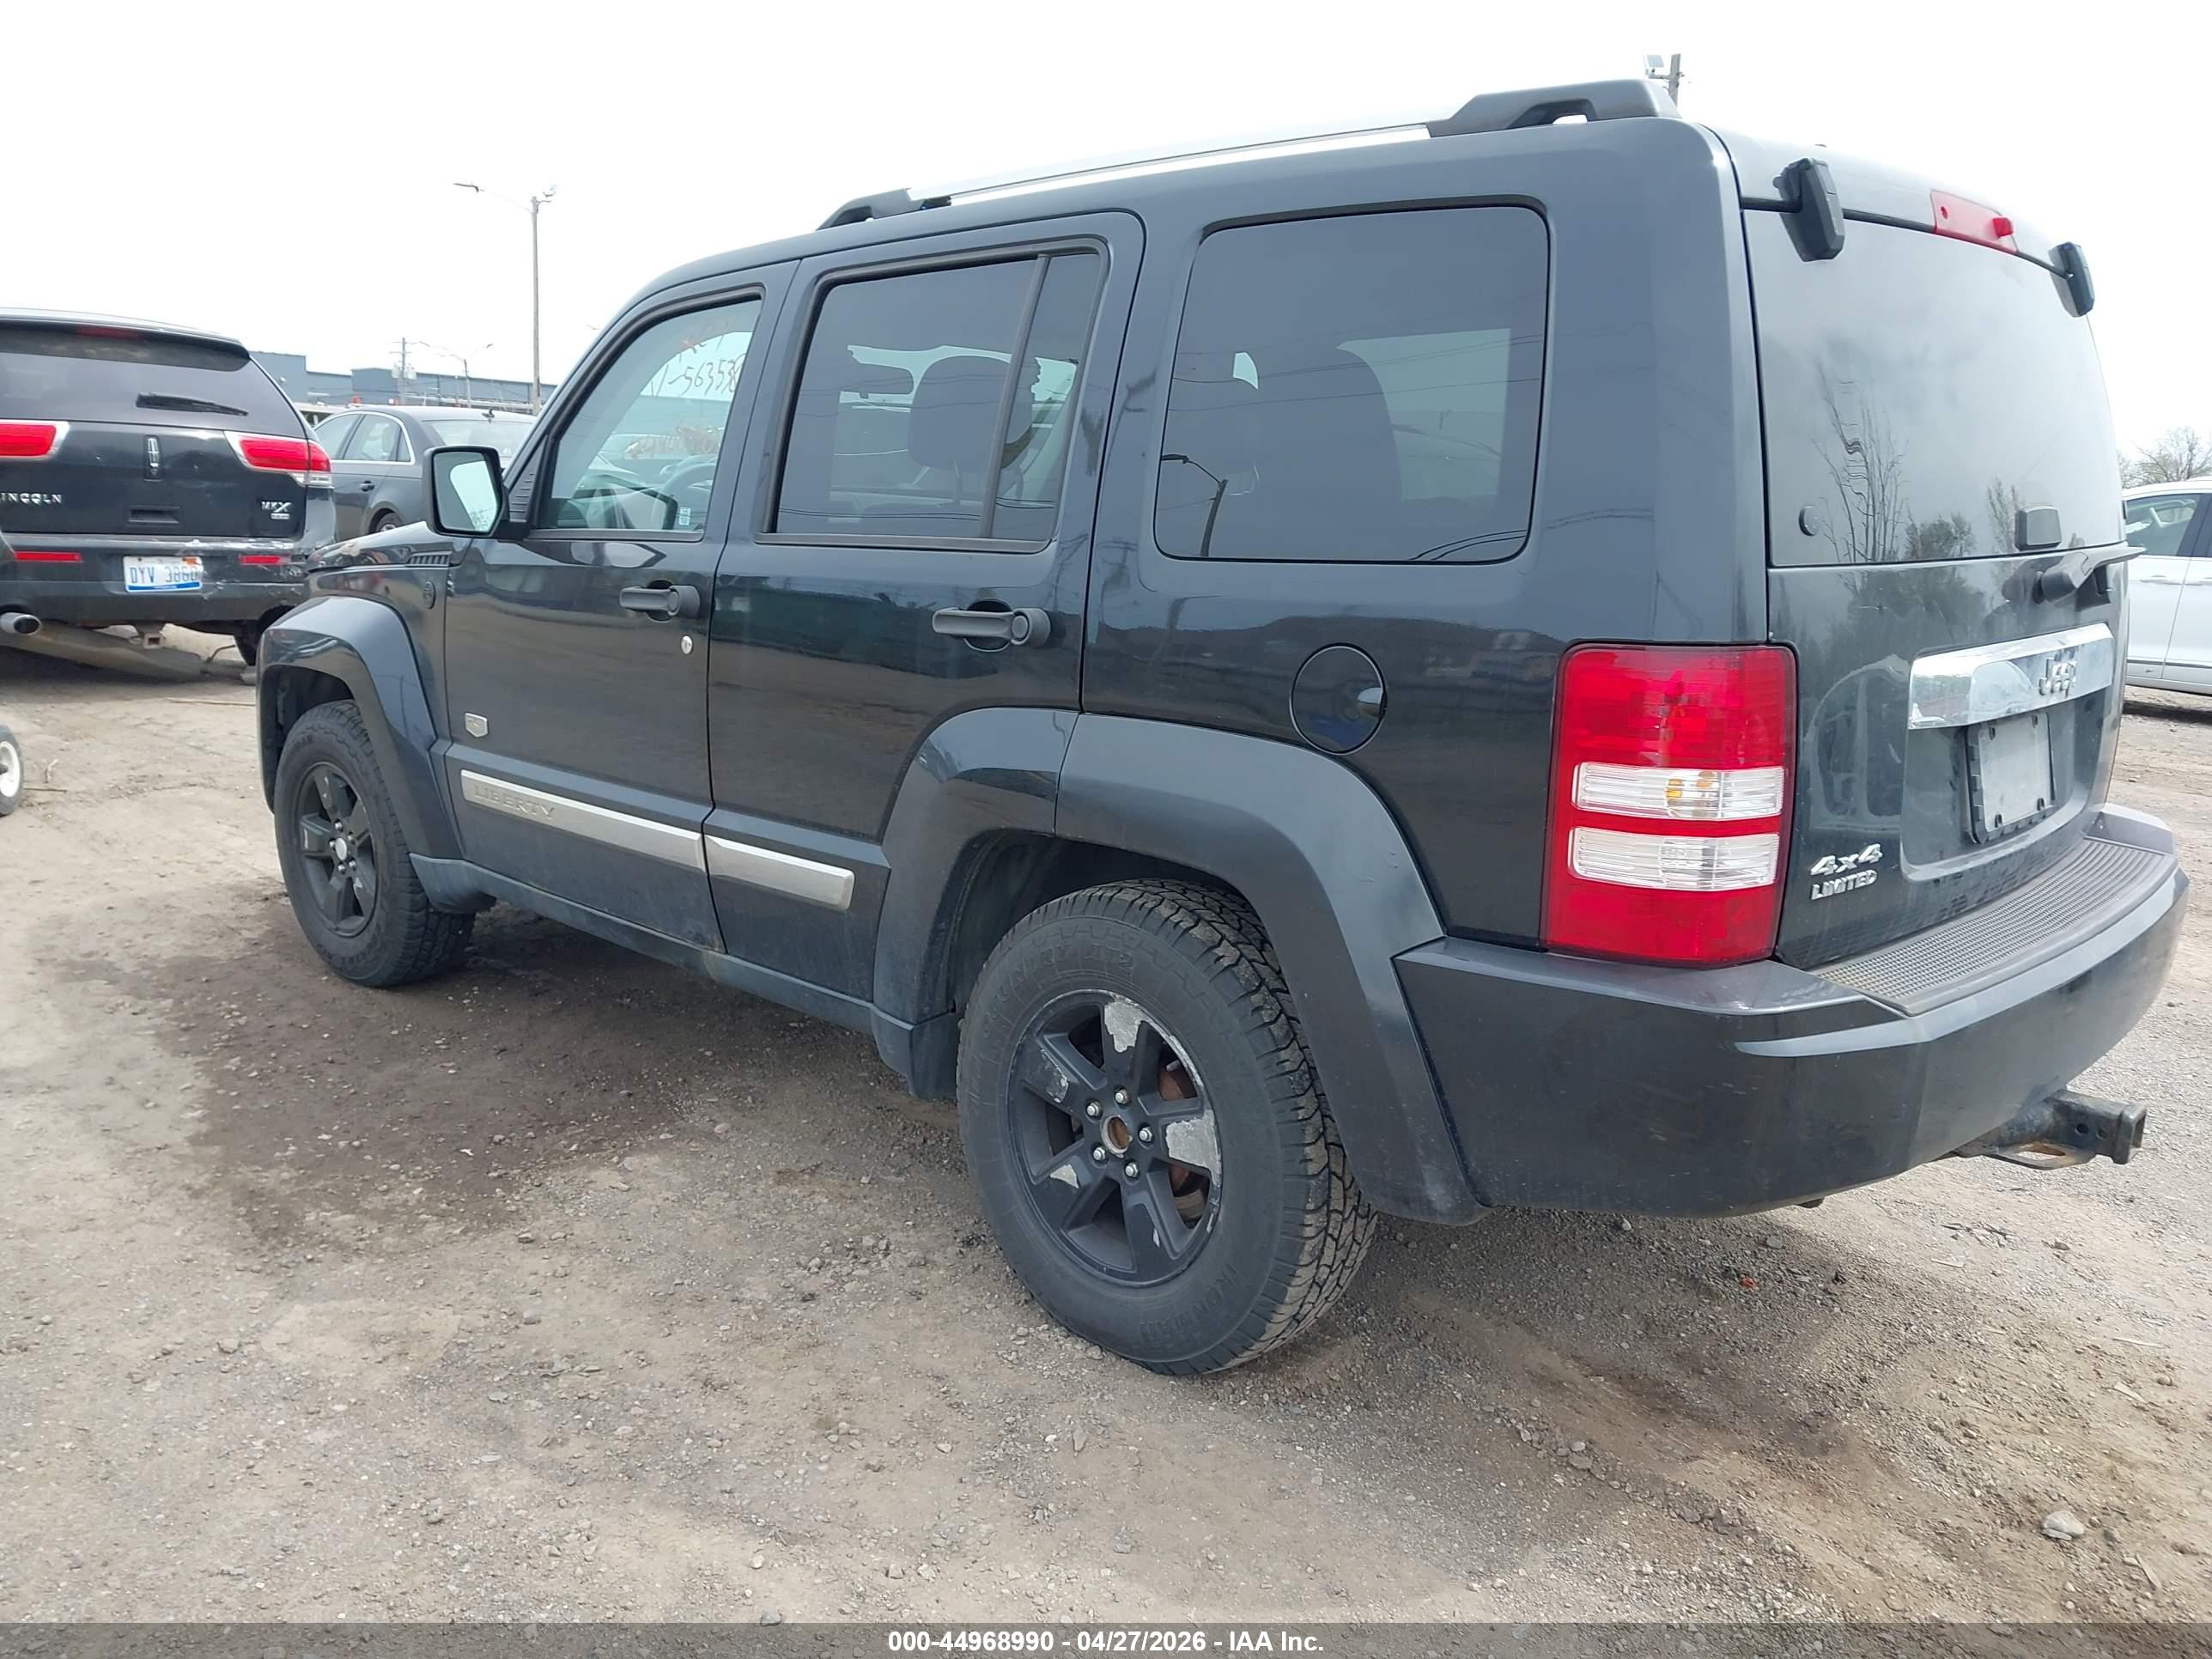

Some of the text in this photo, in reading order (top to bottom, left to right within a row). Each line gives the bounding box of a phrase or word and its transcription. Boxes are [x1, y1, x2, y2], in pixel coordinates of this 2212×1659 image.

[0, 492, 62, 506] INCOLN
[131, 566, 155, 584] DYV
[2039, 656, 2076, 698] Jeep
[473, 784, 556, 820] LIBERTY
[1809, 842, 1883, 876] 4x4
[1810, 868, 1878, 901] LIMITED
